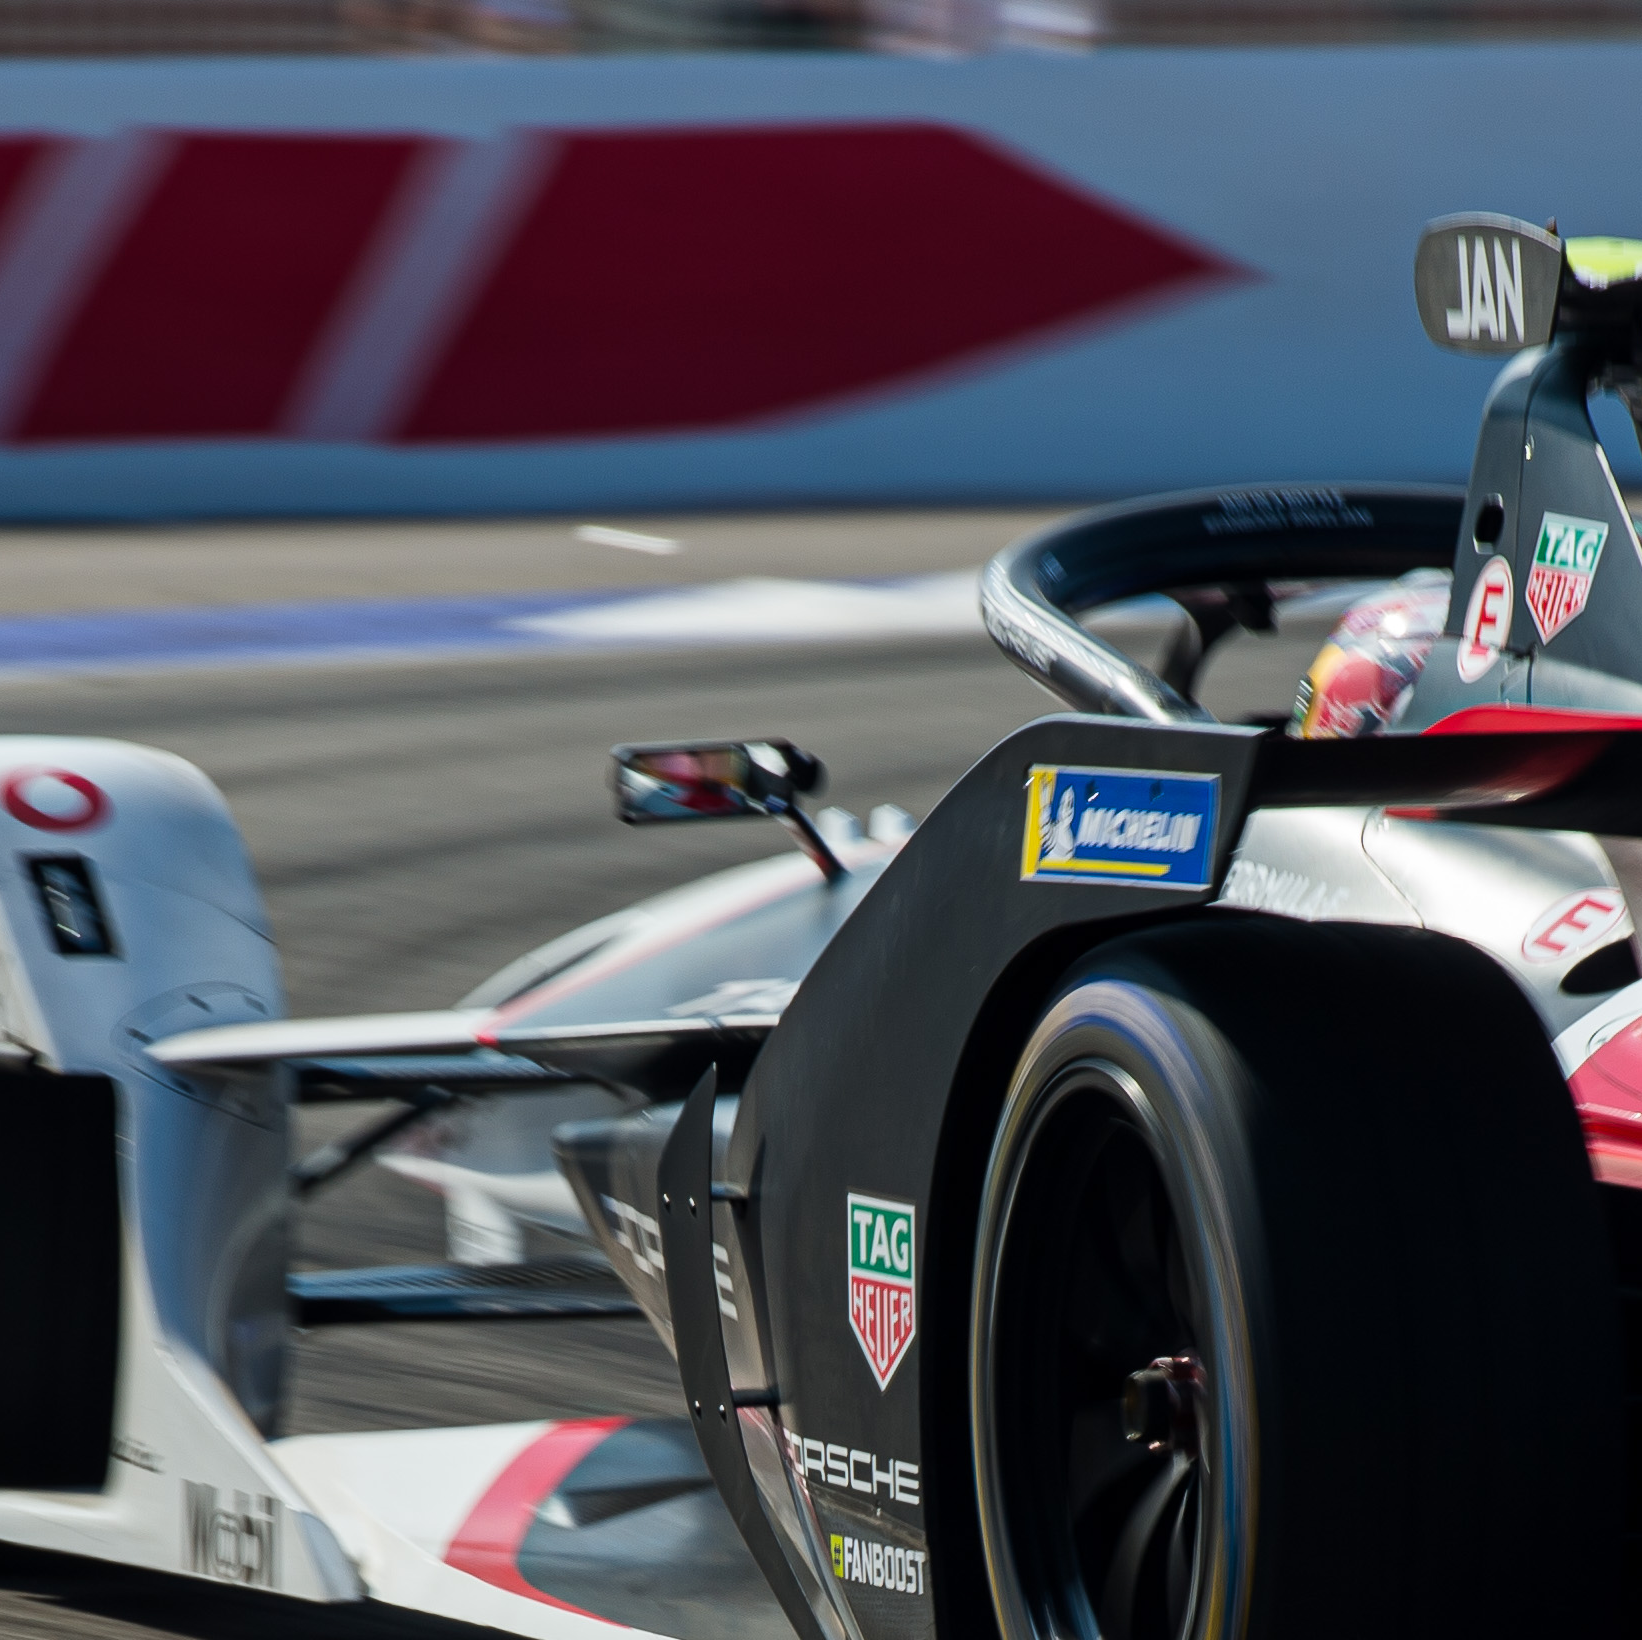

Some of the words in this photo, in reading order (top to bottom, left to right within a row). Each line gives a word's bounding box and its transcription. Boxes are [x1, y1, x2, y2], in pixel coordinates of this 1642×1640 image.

[1445, 233, 1525, 343] JAN
[1544, 521, 1599, 569] TAG
[1527, 567, 1590, 637] HEUER
[1075, 808, 1204, 854] MICHELIN
[853, 1208, 909, 1273] TAG
[852, 1281, 912, 1372] HEUER
[843, 1535, 926, 1596] FANBOOST
